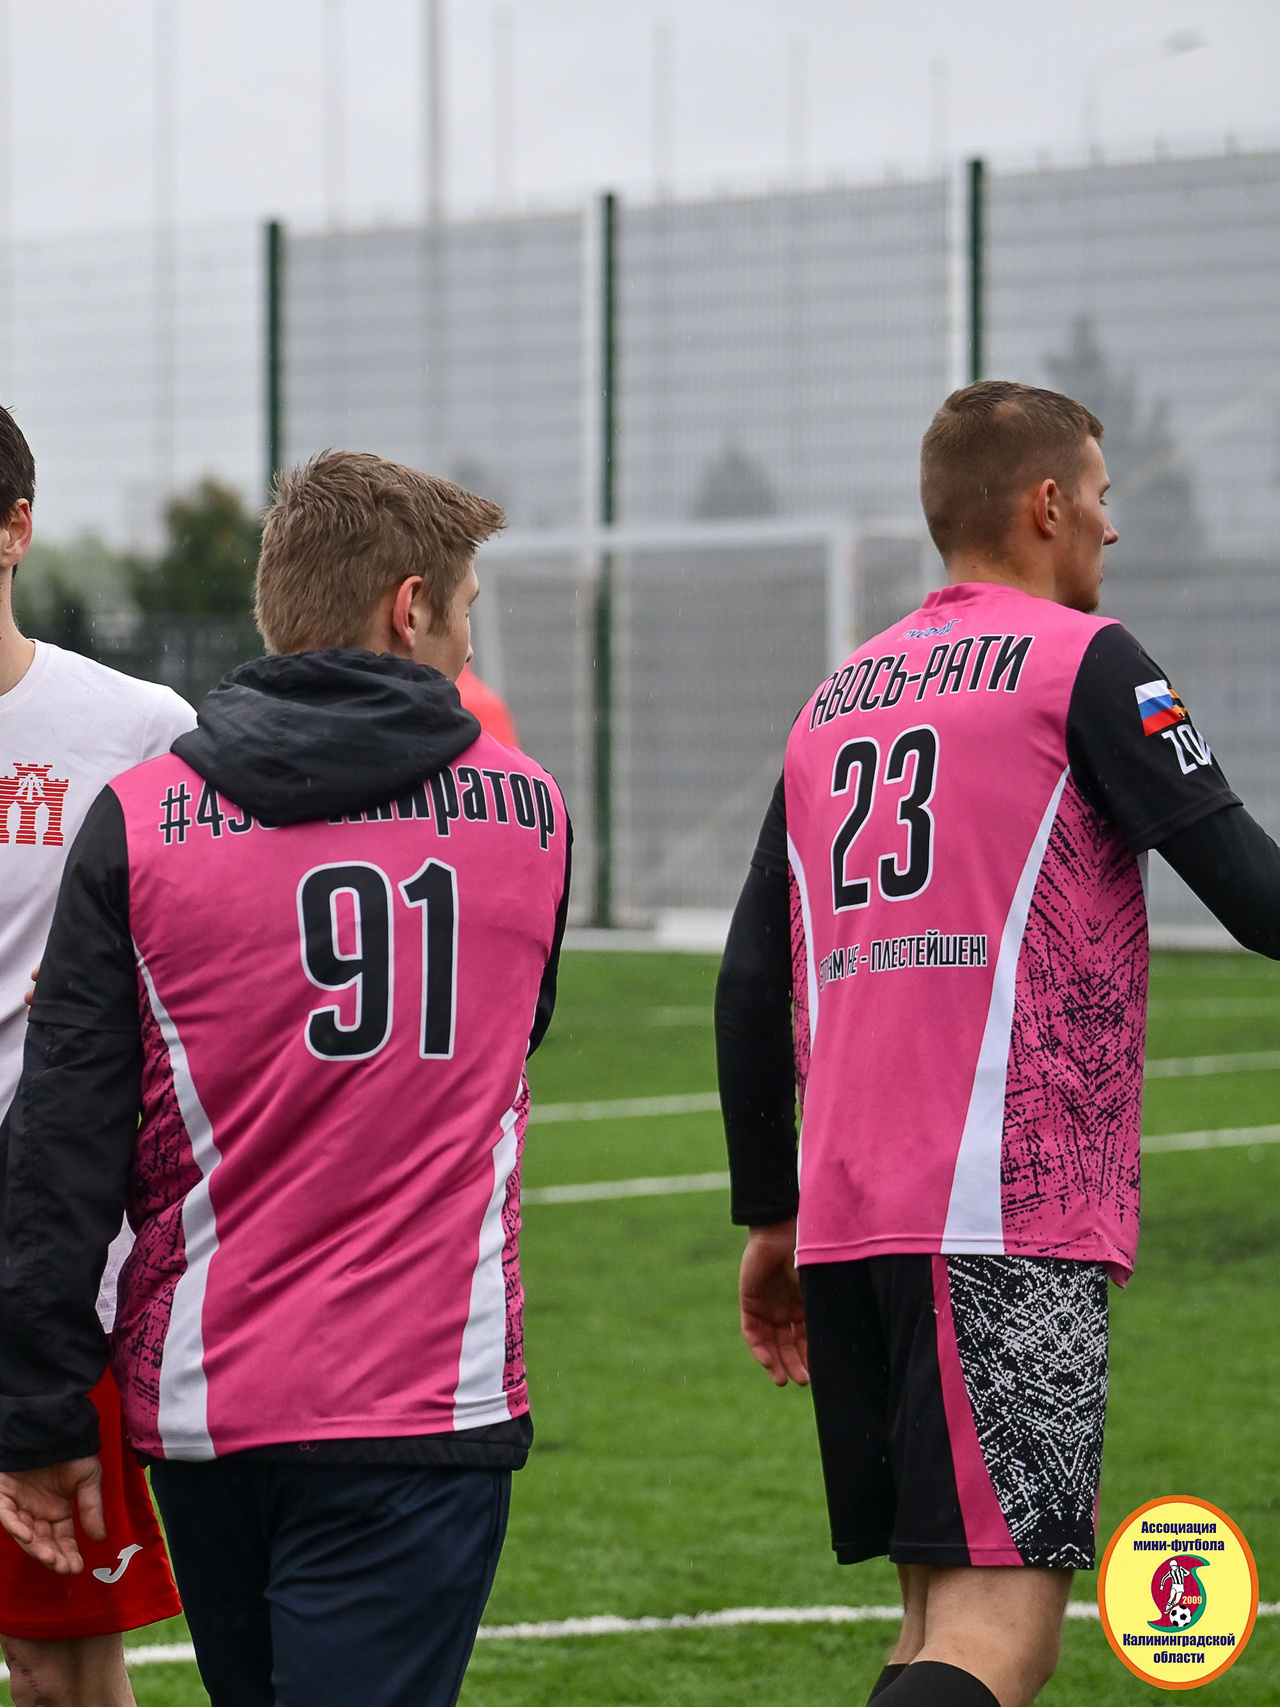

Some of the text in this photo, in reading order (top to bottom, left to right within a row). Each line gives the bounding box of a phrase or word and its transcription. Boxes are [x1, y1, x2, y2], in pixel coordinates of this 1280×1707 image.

[810, 634, 1035, 732] АВОСЬ-РАТИ
[831, 724, 940, 914] 23
[296, 857, 459, 1061] 91
[870, 929, 988, 972] ПЛЕСТЕЙШЕН!
